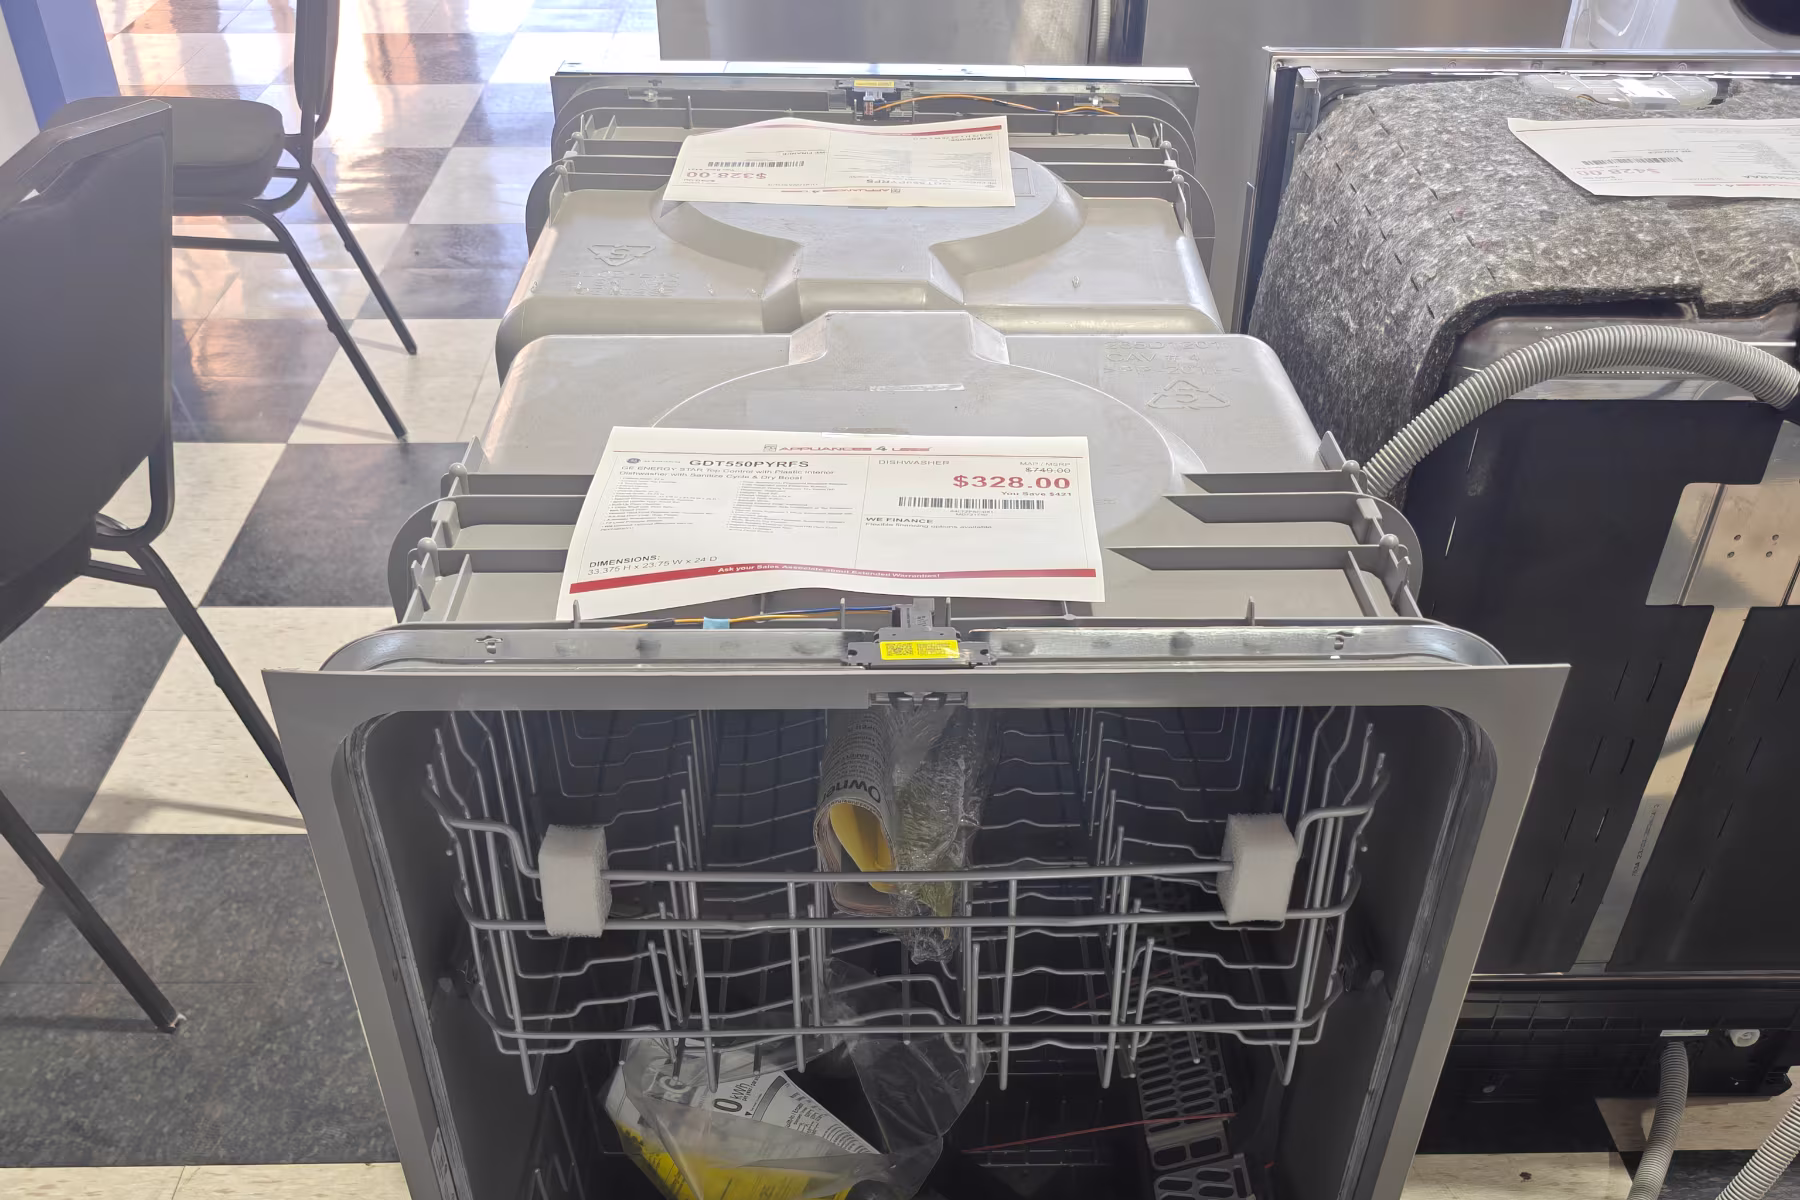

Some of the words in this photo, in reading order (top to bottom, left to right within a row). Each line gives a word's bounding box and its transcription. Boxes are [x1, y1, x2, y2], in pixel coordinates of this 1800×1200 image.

[686, 171, 768, 180] $328.00
[689, 459, 810, 468] GDT550PYRFS
[953, 474, 1071, 489] $328.00
[589, 554, 662, 568] DIMENSIONS:
[587, 567, 621, 576] 33.375
[643, 561, 670, 569] 23.75
